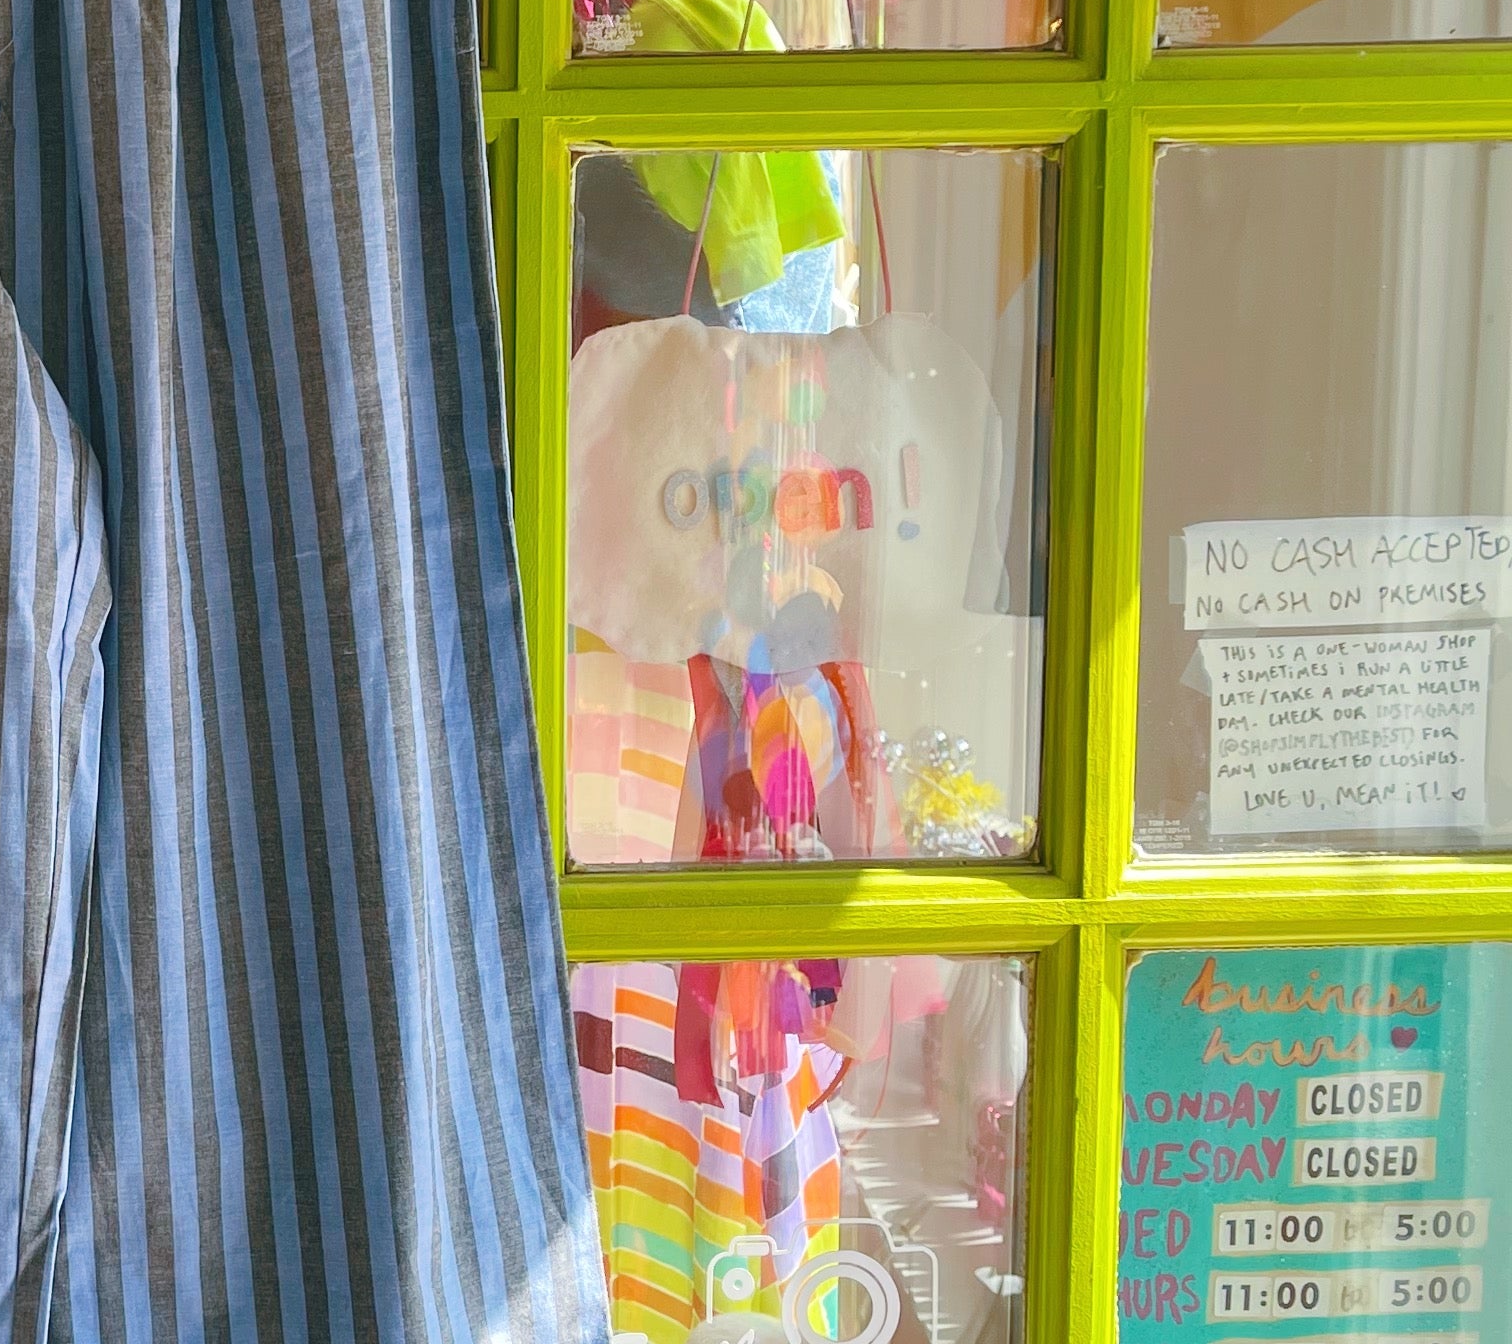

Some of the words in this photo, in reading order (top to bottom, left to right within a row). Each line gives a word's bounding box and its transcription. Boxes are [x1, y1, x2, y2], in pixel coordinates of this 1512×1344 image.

[1206, 539, 1248, 575] NO
[1271, 536, 1357, 576] CASH
[1240, 592, 1312, 614] CASH
[1329, 586, 1361, 611] ON
[1379, 582, 1486, 613] PREMISES
[1293, 646, 1307, 661] A
[1436, 635, 1477, 650] SHOP
[1358, 662, 1391, 676] RUN
[1399, 662, 1412, 674] A
[1322, 686, 1334, 700] A
[1418, 679, 1481, 694] HEALTH
[1269, 706, 1324, 727] CHECK
[1332, 706, 1367, 721] OUR
[1376, 702, 1476, 719] INSTAGRAM
[1421, 727, 1459, 741] FOR
[1217, 763, 1256, 779] ANY
[1267, 754, 1373, 775] UNEXPECTED
[1244, 789, 1289, 812] LOVE
[1337, 783, 1396, 806] MEAN
[1182, 956, 1441, 1017] business
[1201, 1025, 1370, 1067] hours
[1311, 1081, 1422, 1115] CLOSED
[1122, 1136, 1286, 1187] UESDAY
[1307, 1145, 1419, 1178] CLOSED
[1226, 1215, 1324, 1246] 11:00
[1394, 1210, 1476, 1241] 5:00
[1222, 1281, 1320, 1311] 11:00
[1391, 1276, 1472, 1307] 5:00
